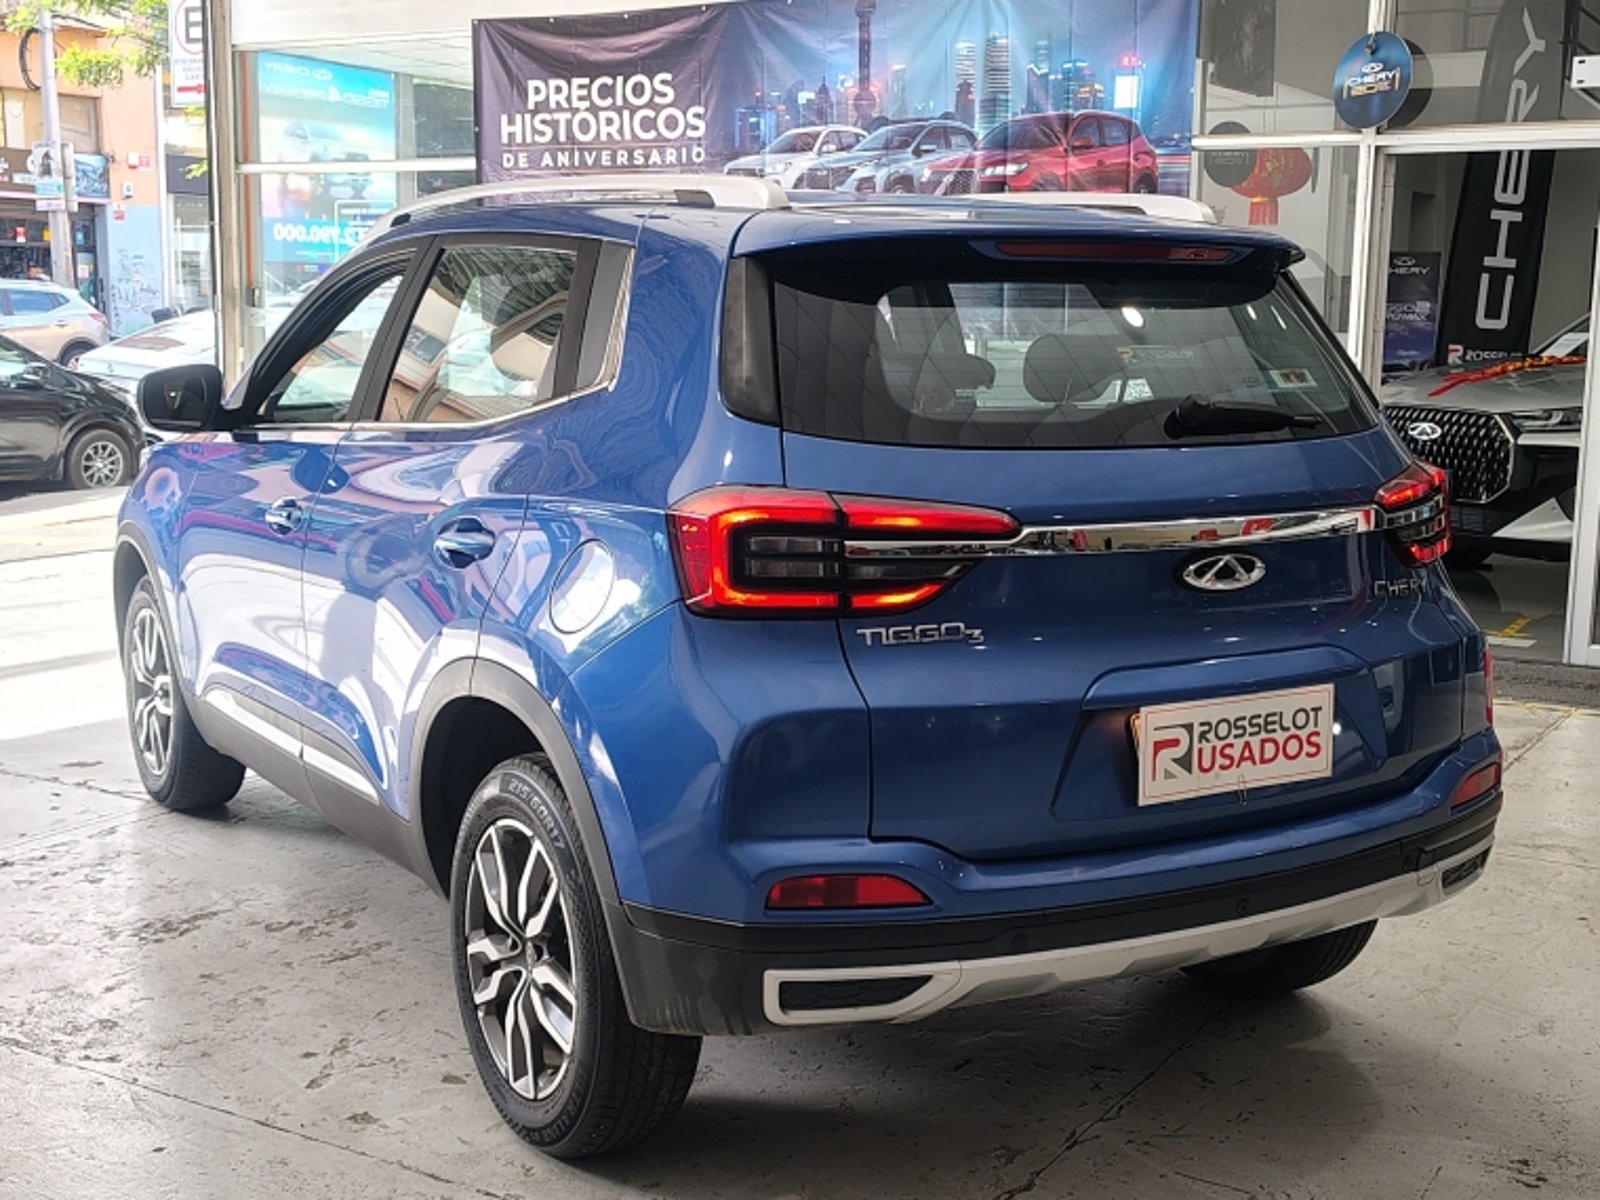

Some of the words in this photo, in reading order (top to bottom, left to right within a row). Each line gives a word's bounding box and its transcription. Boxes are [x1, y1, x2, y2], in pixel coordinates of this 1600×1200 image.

[527, 73, 675, 110] PRECIOS
[500, 106, 706, 145] HISTÓRICOS
[502, 152, 529, 168] DE
[541, 146, 706, 167] ANIVERSARIO
[1475, 5, 1547, 331] CHERY
[1388, 266, 1430, 276] HERY
[1198, 706, 1323, 744] ROSSELOT
[1197, 731, 1321, 775] USADOS
